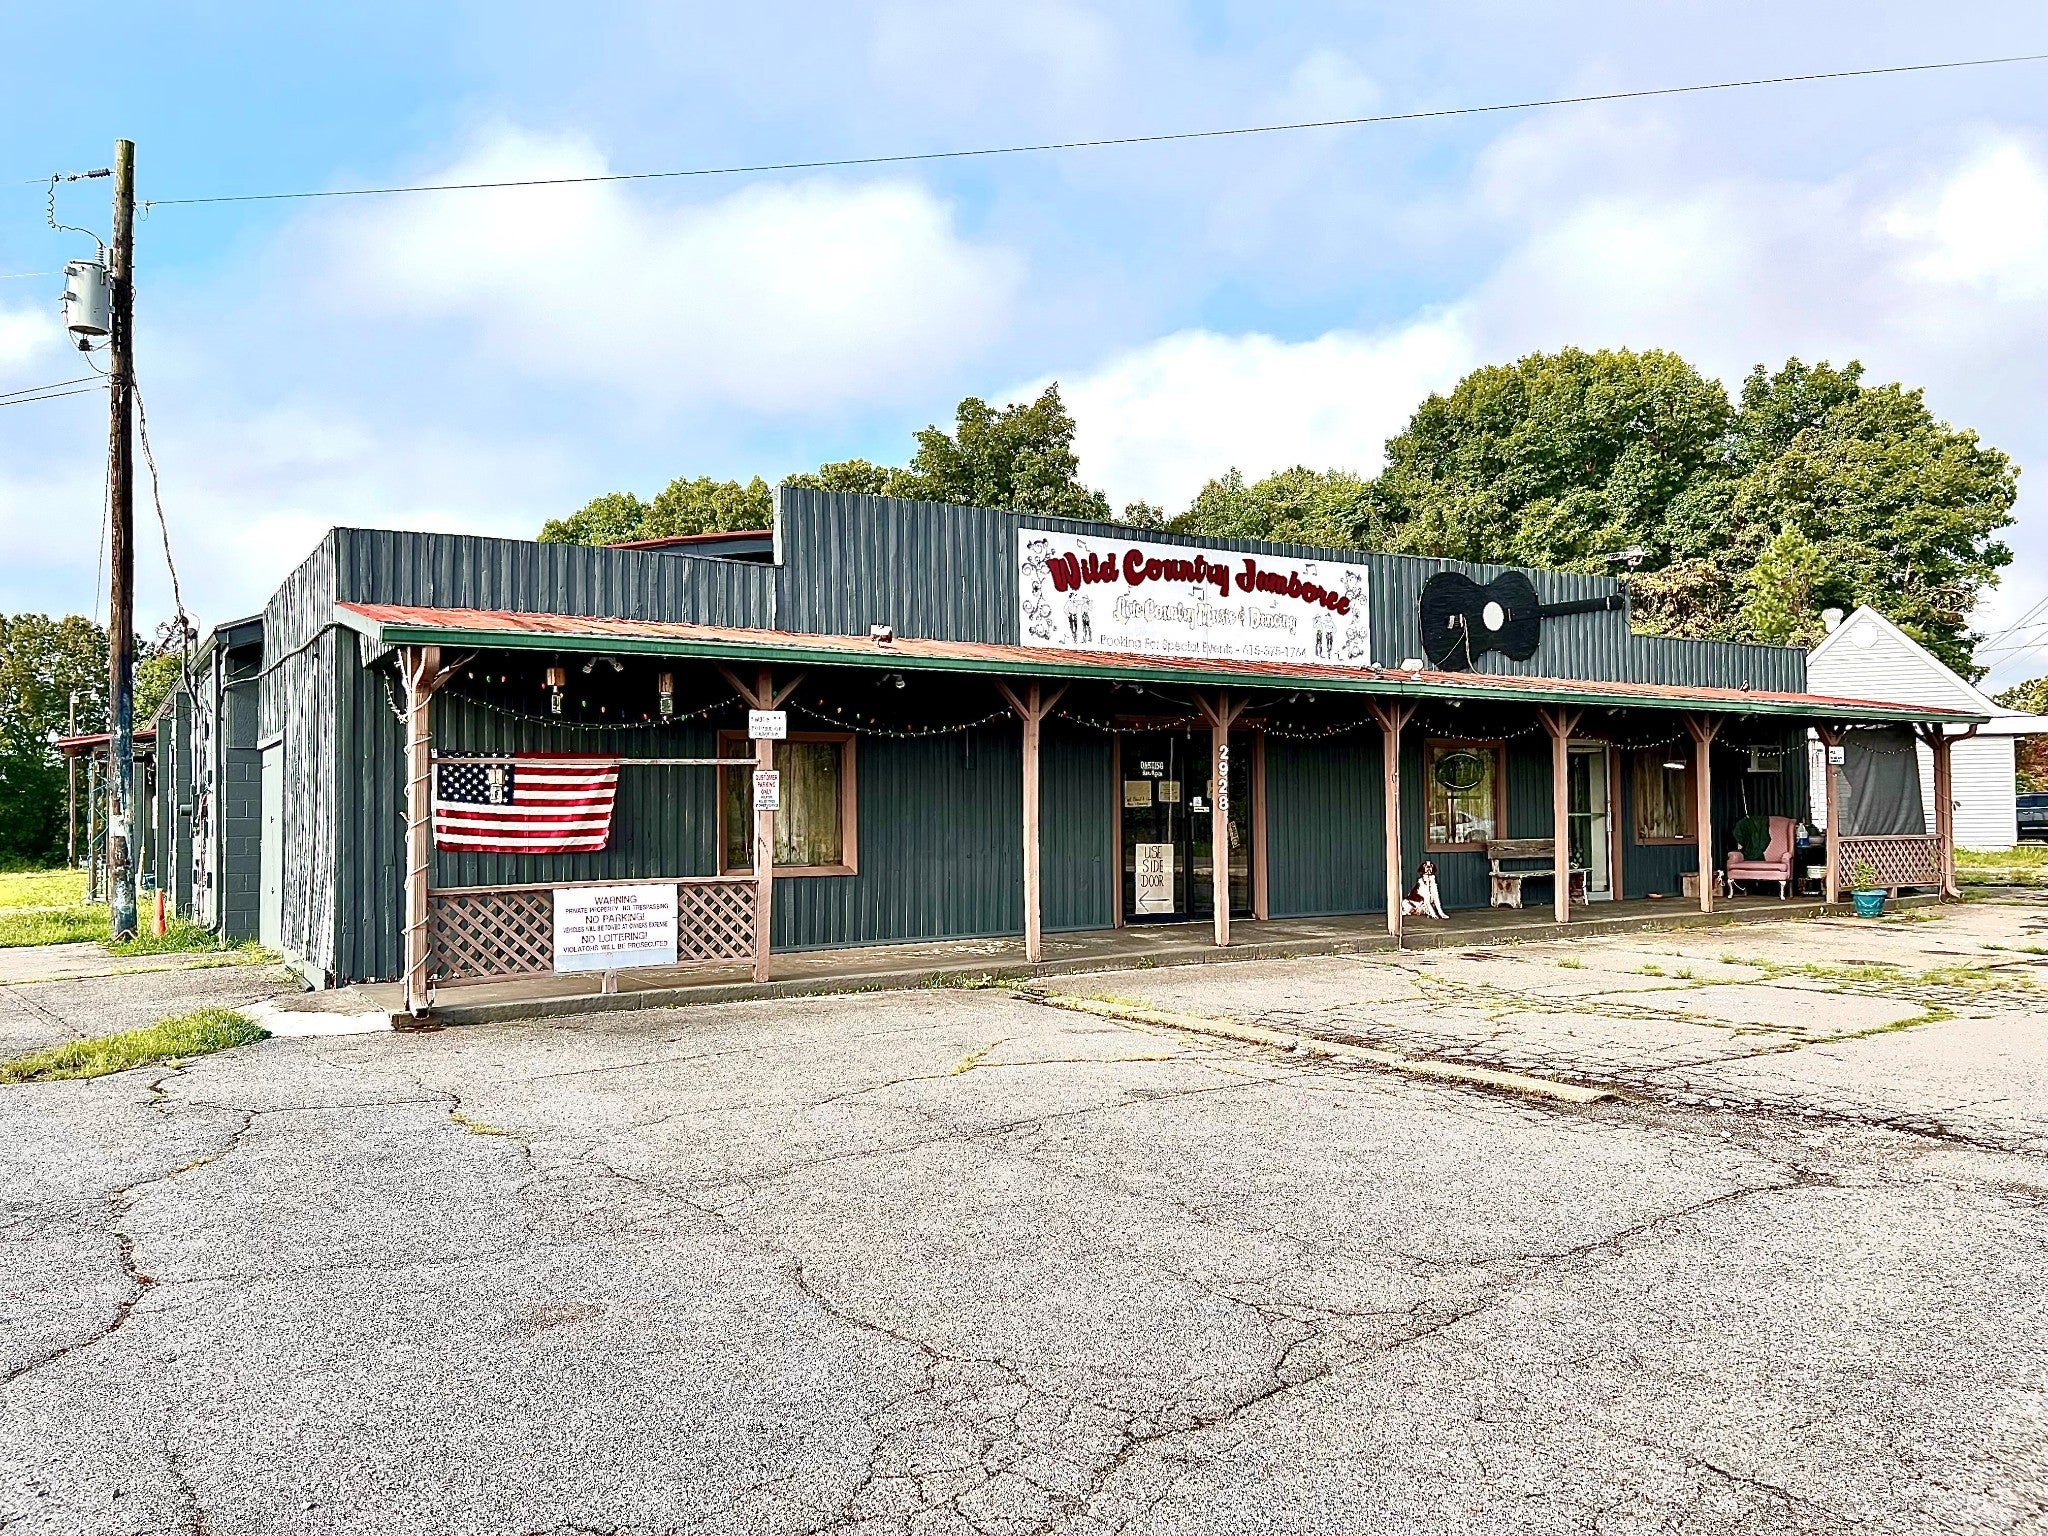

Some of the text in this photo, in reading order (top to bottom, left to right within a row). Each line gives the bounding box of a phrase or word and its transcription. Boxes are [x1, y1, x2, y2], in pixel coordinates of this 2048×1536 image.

[1045, 548, 1351, 616] Wild Country Jamboree
[1113, 595, 1143, 625] Live
[1143, 597, 1196, 630] Country
[1196, 602, 1237, 628] Music
[1248, 606, 1299, 635] Dancing
[1100, 634, 1142, 649] Booking
[1144, 637, 1160, 650] For
[1161, 638, 1200, 654] Special
[1202, 641, 1234, 655] Events
[1217, 744, 1229, 811] 2928
[1144, 845, 1163, 860] USE
[1142, 859, 1164, 874] SIDE
[1140, 874, 1164, 888] DOOR
[594, 894, 638, 905] WARNING
[589, 906, 619, 914] PROPERTY
[585, 912, 645, 924] NO PARKING!
[581, 931, 648, 944] NO LOITERING!
[563, 940, 668, 953] VIOLATORS WILL BE PROSECUTED
